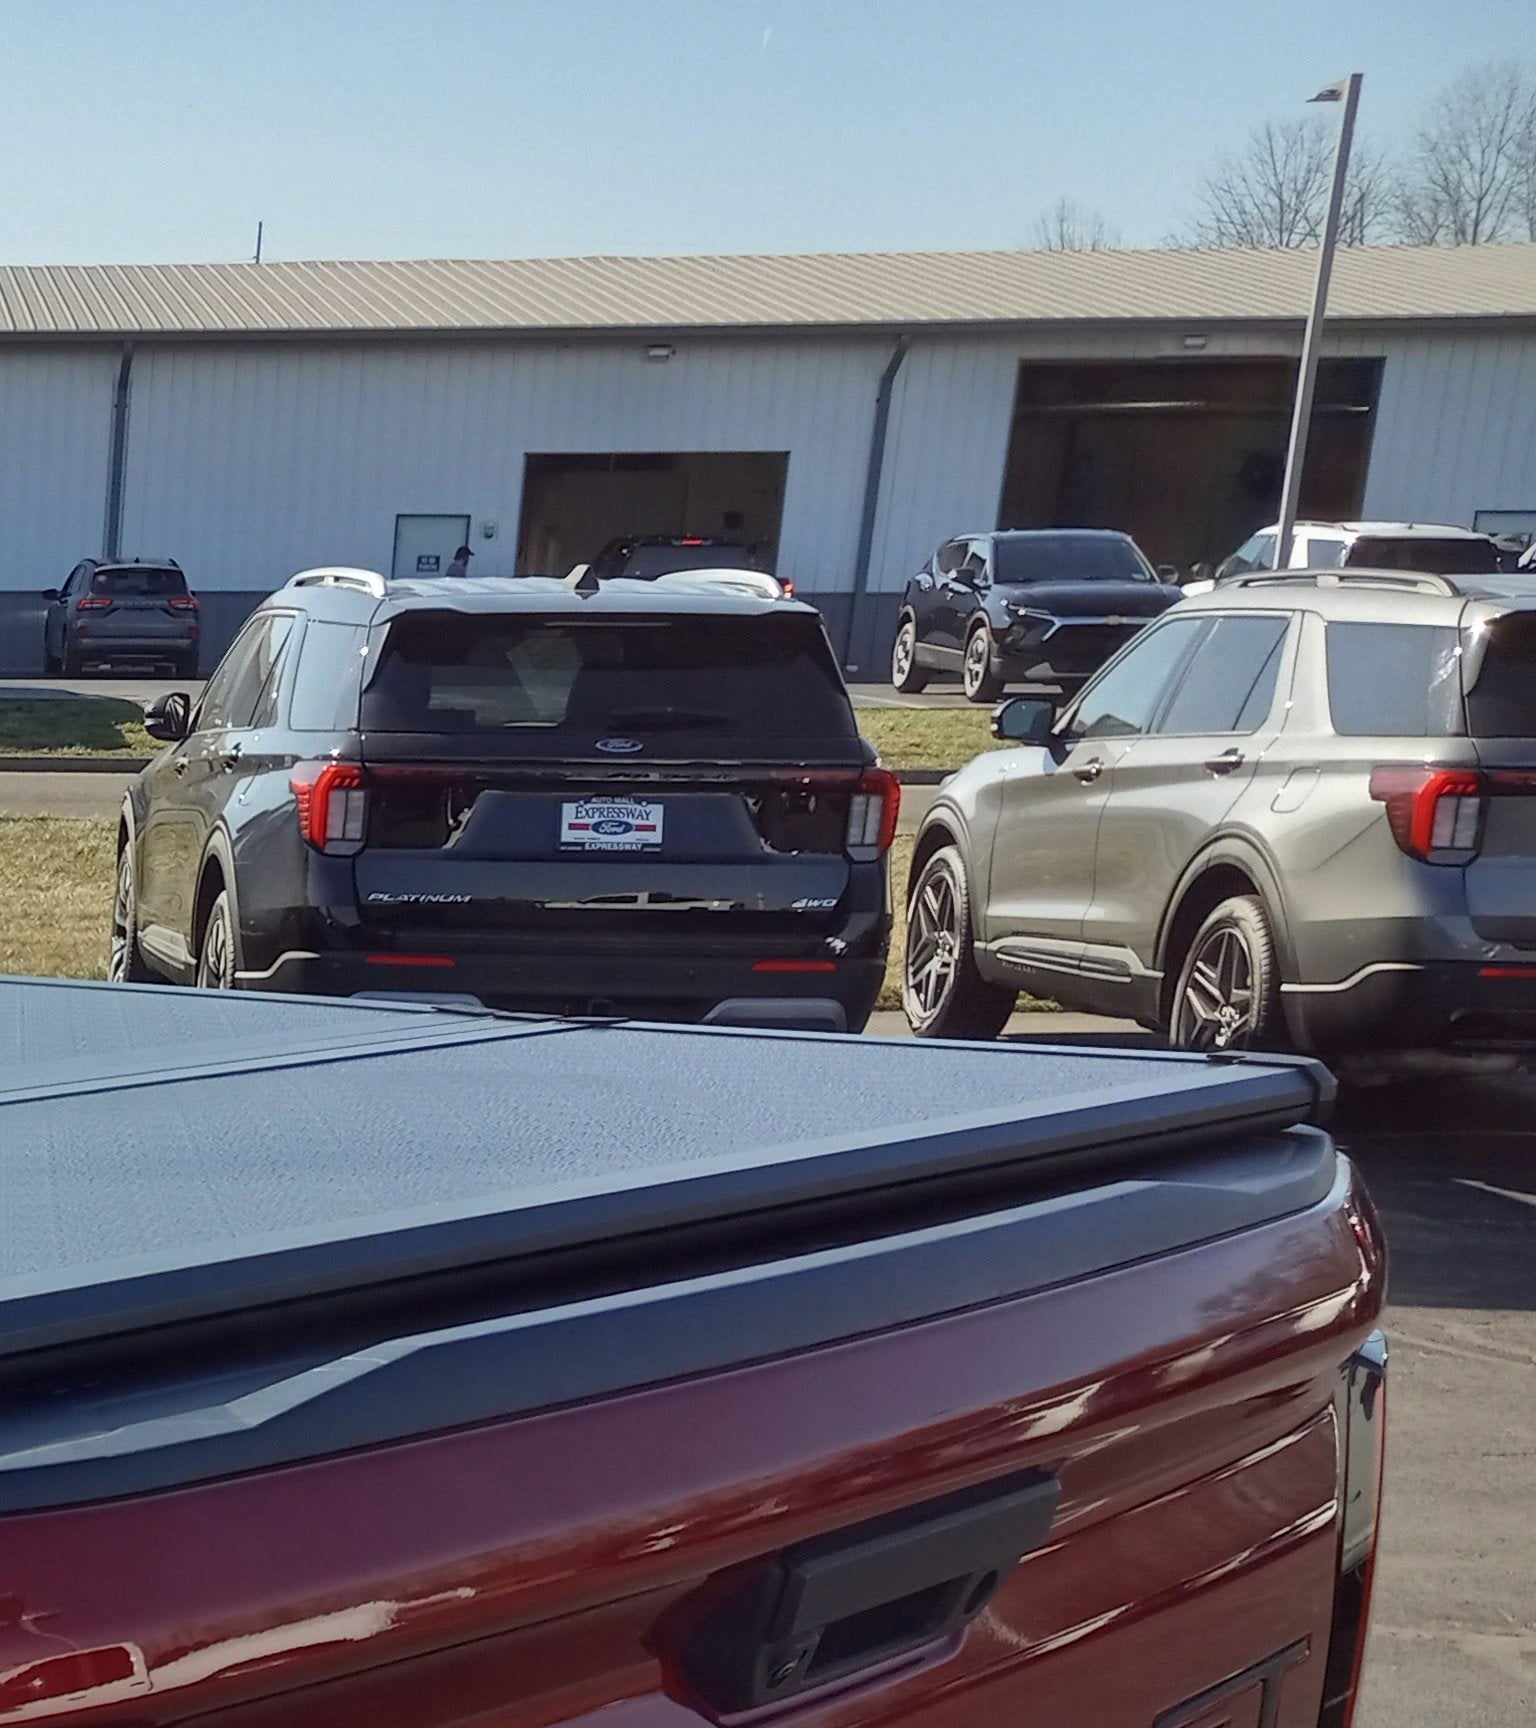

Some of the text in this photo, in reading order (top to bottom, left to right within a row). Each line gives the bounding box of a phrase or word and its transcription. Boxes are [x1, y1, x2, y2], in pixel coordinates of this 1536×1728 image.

[574, 805, 653, 821] EXPRESSWAY
[598, 822, 626, 833] Ford
[584, 842, 643, 850] EXPRESSWAY
[368, 893, 472, 903] PLATINUM
[791, 898, 839, 908] 4WD
